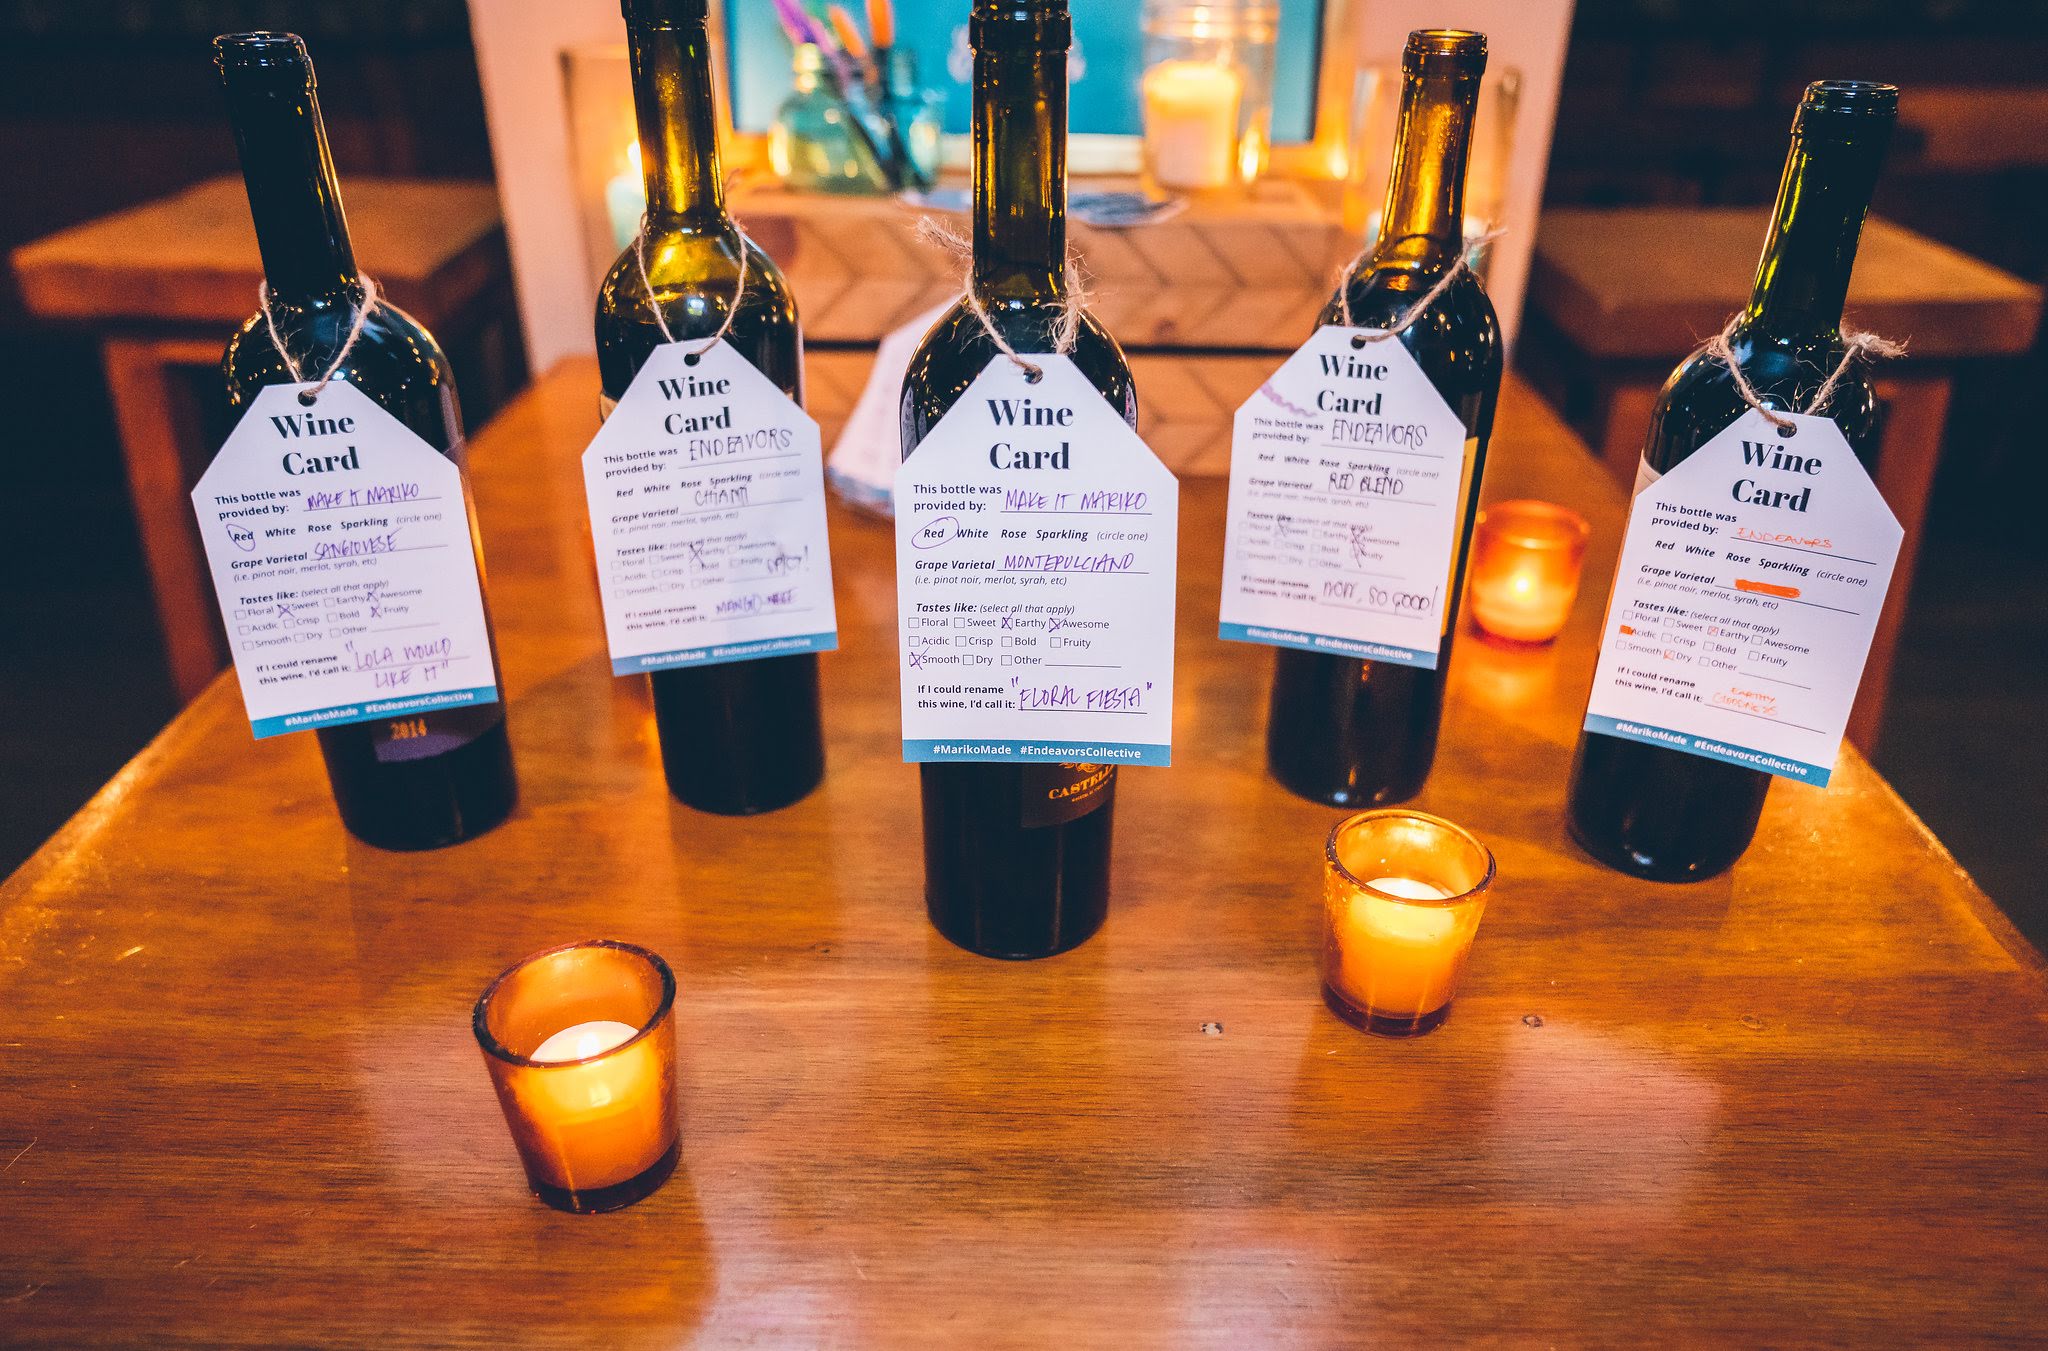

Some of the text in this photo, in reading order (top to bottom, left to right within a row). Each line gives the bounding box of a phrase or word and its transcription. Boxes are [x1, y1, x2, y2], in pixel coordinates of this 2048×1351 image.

[1320, 355, 1388, 380] Wine
[658, 376, 730, 400] Wine
[986, 399, 1073, 426] Wine
[1317, 390, 1382, 415] Card
[269, 413, 354, 438] Wine
[665, 406, 730, 434] Card
[1254, 418, 1272, 426] This
[1275, 420, 1302, 429] bottle
[1253, 433, 1309, 444] provided by:
[1332, 419, 1428, 450] ENDEAVORS
[689, 429, 793, 461] ENDEAVORS
[283, 446, 359, 475] Card
[604, 455, 623, 464] This
[627, 451, 655, 460] bottle
[990, 442, 1069, 469] Card
[1742, 441, 1822, 475] Wine
[606, 463, 665, 479] provided by:
[1285, 456, 1309, 465] White
[1320, 459, 1340, 467] Rose
[1348, 462, 1390, 476] Sparkling
[617, 488, 633, 497] Red
[644, 485, 670, 493] White
[710, 475, 752, 489] Sparkling
[914, 484, 937, 494] This
[941, 484, 975, 494] bottle
[1328, 472, 1404, 495] RED BLEND
[214, 496, 238, 504] This
[242, 491, 275, 502] bottle
[307, 483, 419, 511] MAKE IT MARIKO
[1005, 489, 1148, 512] MAKE IT MARIKO
[1732, 479, 1811, 512] Card
[219, 505, 289, 521] provided by:
[612, 507, 678, 523] Grape Varietal
[914, 501, 986, 512] provided by:
[1656, 502, 1736, 522] This bottle was
[233, 530, 254, 542] Red
[266, 528, 295, 537] White
[341, 518, 388, 530] Sparkling
[397, 515, 420, 524] (circle
[424, 513, 441, 521] one)
[924, 528, 1148, 542] Red White Rose Sparkling (circle one)
[1652, 518, 1718, 535] provided by:
[315, 533, 400, 560] SANGIOVESE
[231, 552, 307, 569] Grape Varietal
[915, 560, 995, 572] Grape Varietal
[1004, 553, 1135, 573] MONTEPULCIANO
[1655, 540, 1867, 586] Red White Rose Sparkling (circle one)
[915, 576, 1067, 586] (i.e. pinot noir, merlot, syrah, etc)
[1641, 565, 1715, 584] Grape Varietal
[240, 592, 298, 604] Tastes like:
[917, 603, 1074, 615] Tastes like: (select all that apply)
[1634, 600, 1664, 612] Tastes
[1667, 606, 1688, 616] like:
[1690, 611, 1717, 622] (select
[1732, 620, 1750, 629] that
[1752, 625, 1779, 635] apply)
[922, 618, 1109, 629] Floral Sweet Earthy Awesome
[1635, 613, 1809, 654] Floral Sweet Earthy Awesome
[922, 637, 1091, 648] Acidic Crisp Bold Fruity
[1630, 628, 1788, 667] Acidic Crisp Bold Fruity
[922, 655, 1042, 666] Smooth Dry Other
[375, 667, 413, 688] LIKE
[918, 685, 925, 693] If
[934, 685, 961, 693] could
[285, 693, 474, 726] #MarikoMade #EndeavorsCollective
[918, 700, 1015, 709] this wine, I'd call it:
[933, 745, 1141, 758] #MarikoMade #EndeavorsCollective
[1616, 722, 1808, 775] #MarikoMade #EndeavorsCollective
